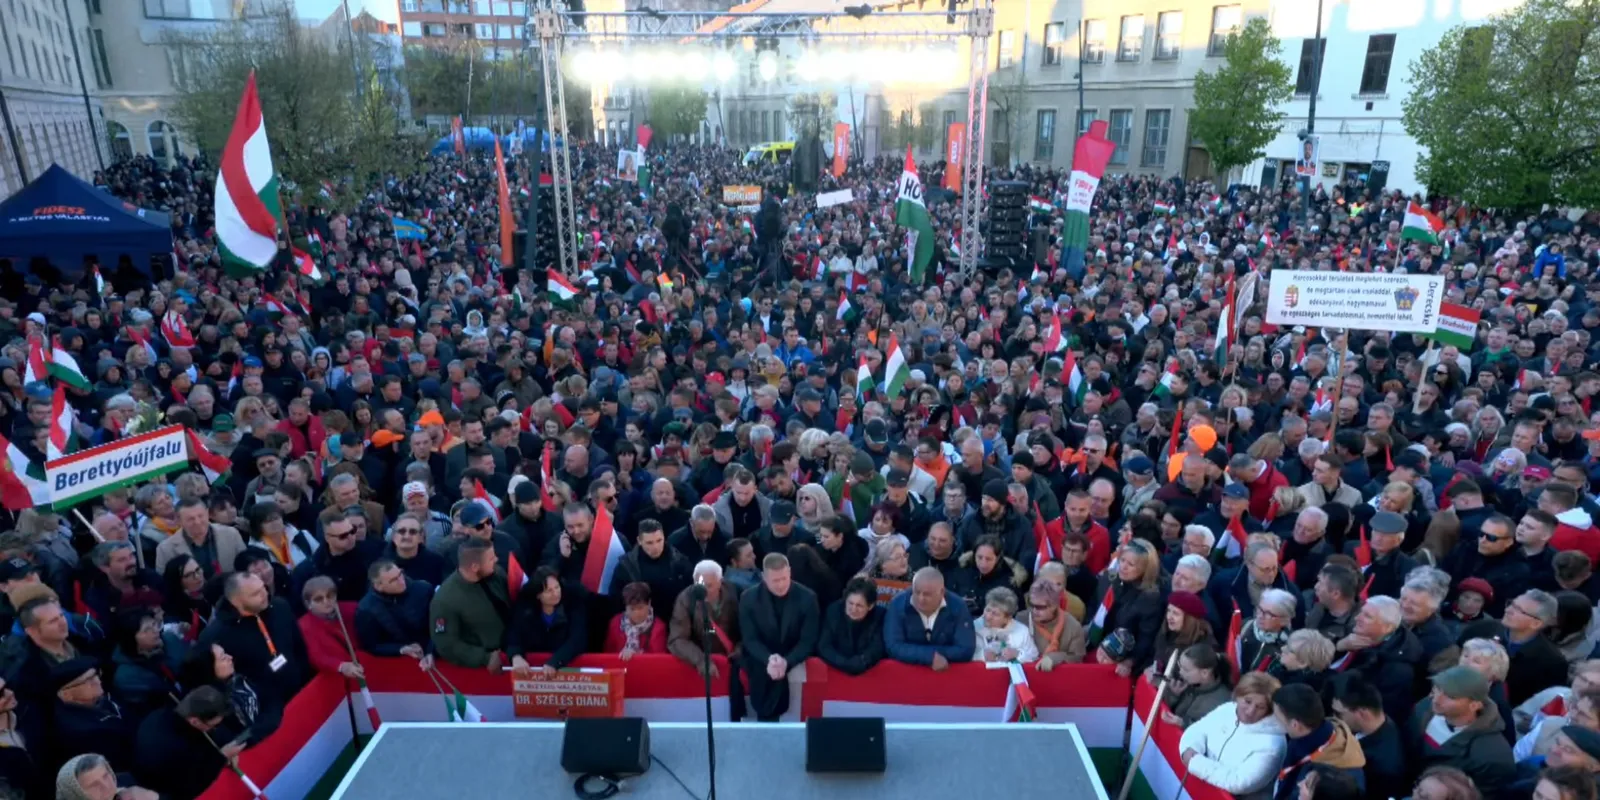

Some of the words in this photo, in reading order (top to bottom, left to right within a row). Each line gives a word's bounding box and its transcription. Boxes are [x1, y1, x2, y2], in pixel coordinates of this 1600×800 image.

[33, 205, 85, 216] FIDESZ
[1422, 281, 1438, 325] Derecske
[55, 440, 181, 491] Berettyóújfalu
[516, 694, 533, 705] DR.
[535, 693, 574, 706] SZÉLES
[575, 695, 608, 707] DIÁNA
